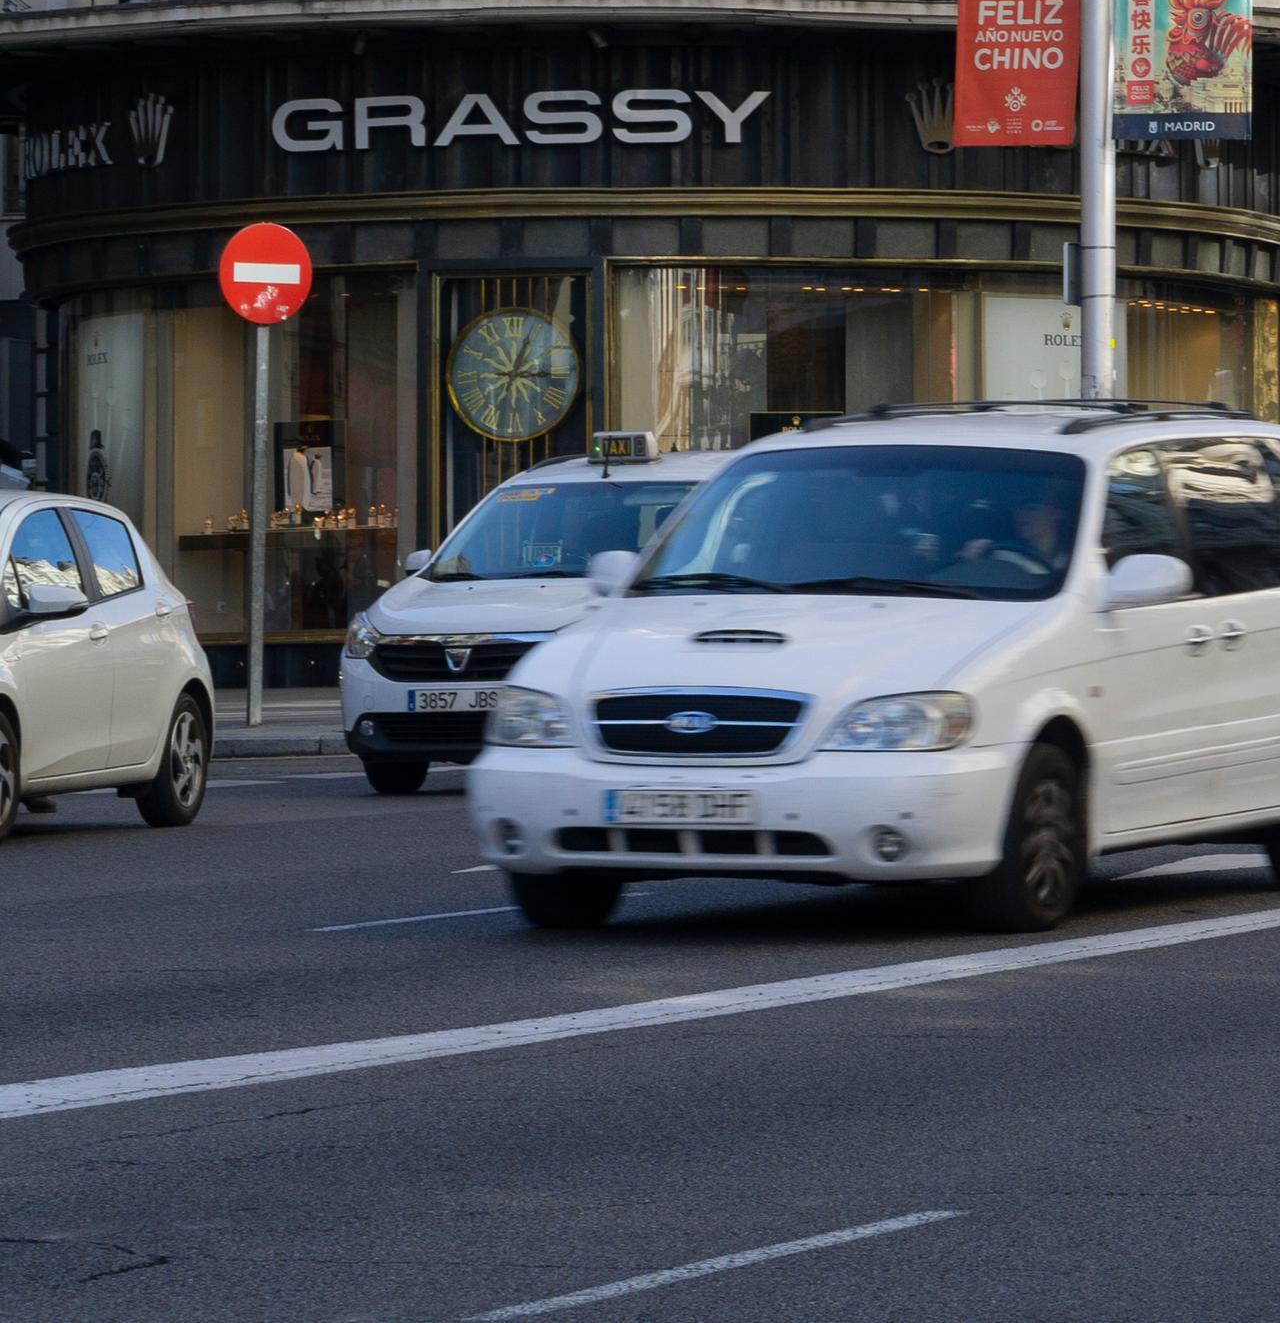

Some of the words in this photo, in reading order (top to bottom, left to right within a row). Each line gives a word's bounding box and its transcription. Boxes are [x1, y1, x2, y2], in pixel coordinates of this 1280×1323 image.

[977, 0, 1064, 25] FELIZ
[975, 27, 1007, 43] AÑO
[1011, 29, 1064, 43] NUEVO
[973, 47, 1064, 71] CHINO
[271, 88, 772, 153] GRASSY
[1164, 121, 1216, 132] MADRID
[1043, 333, 1082, 347] ROLE
[419, 692, 458, 709] 3857
[468, 690, 498, 708] JBS
